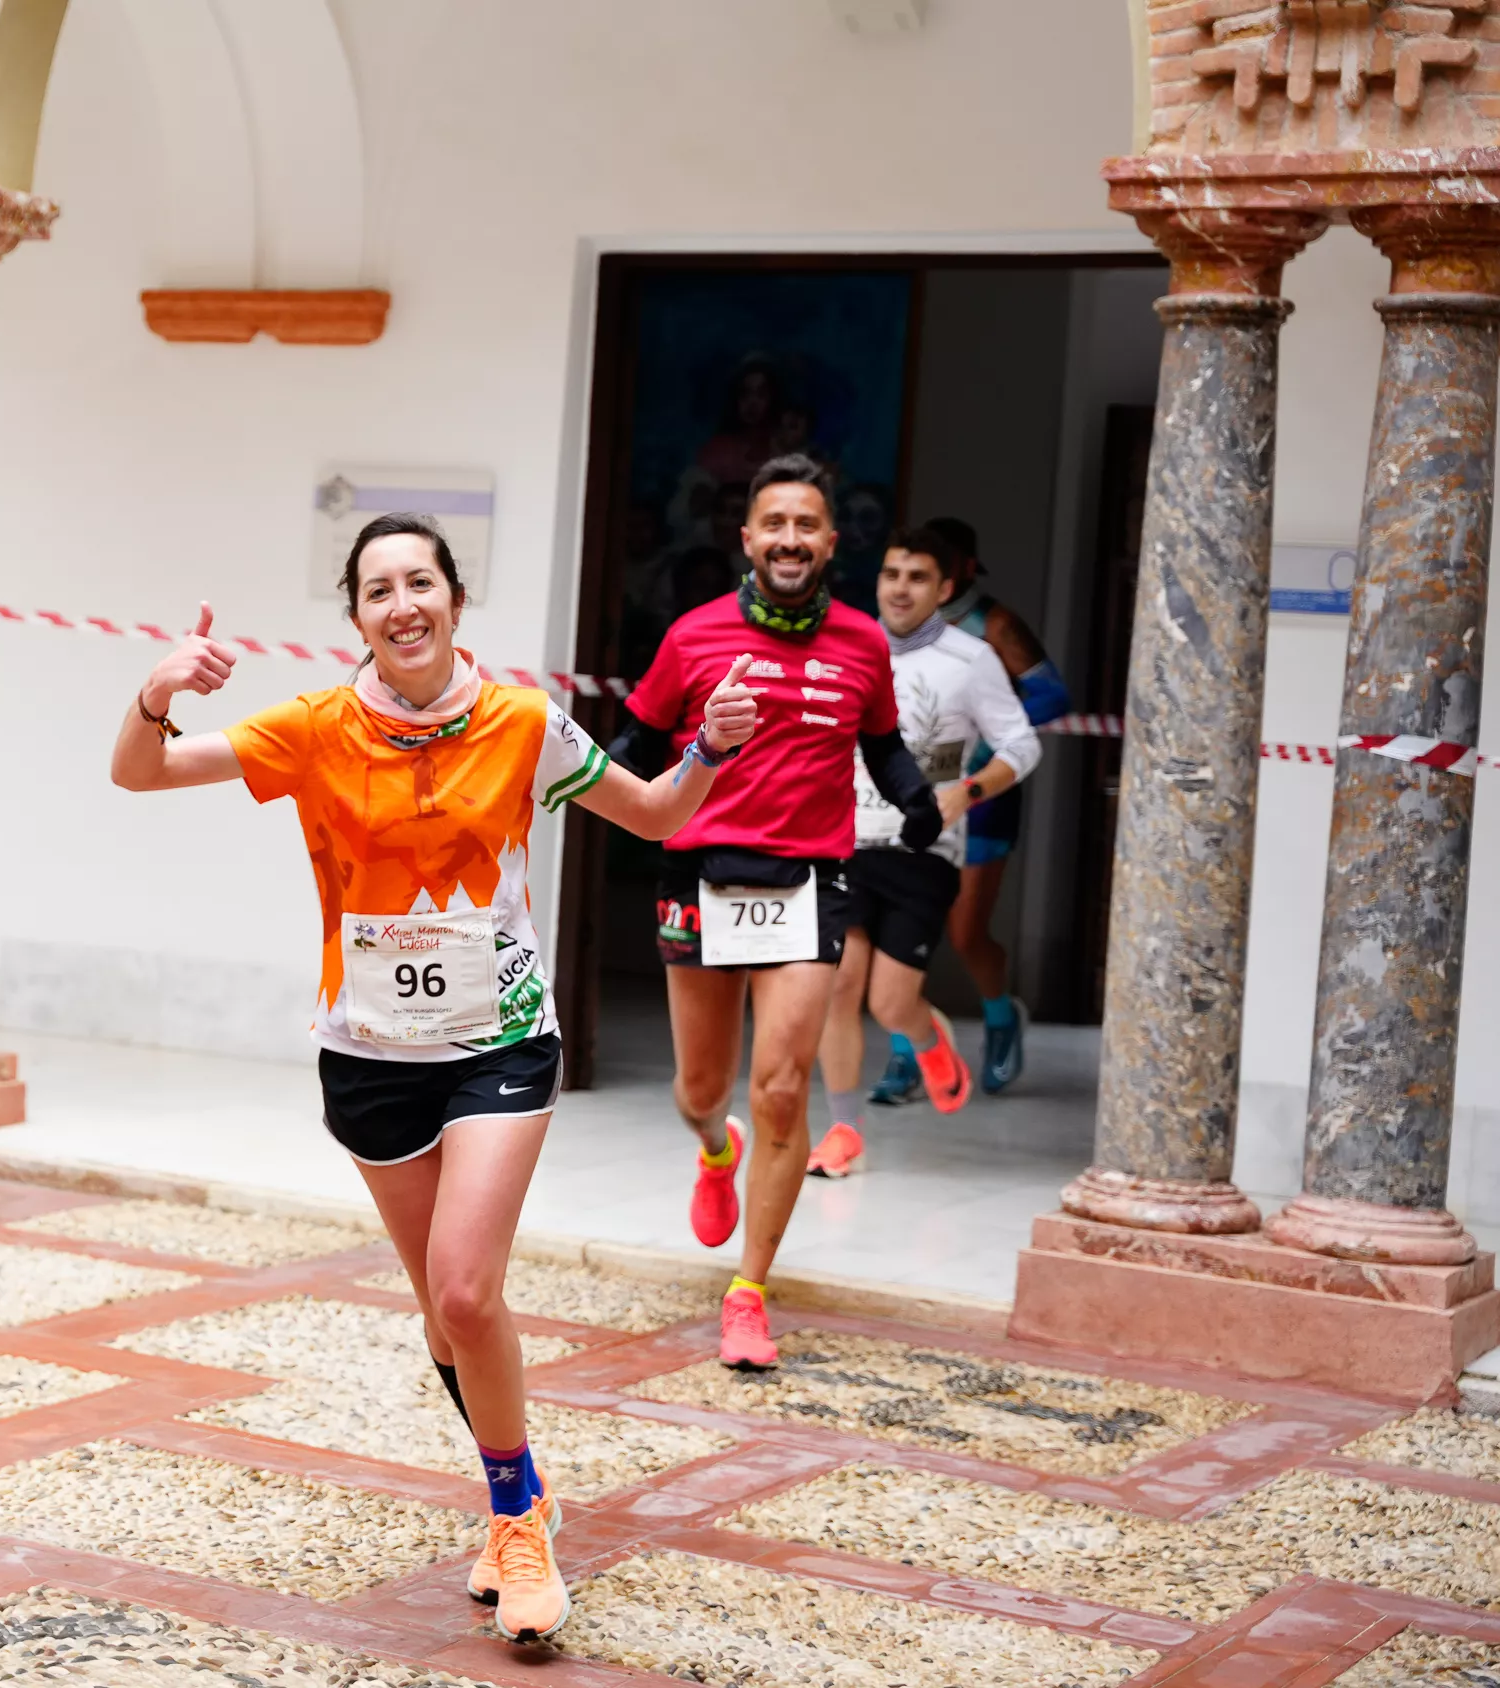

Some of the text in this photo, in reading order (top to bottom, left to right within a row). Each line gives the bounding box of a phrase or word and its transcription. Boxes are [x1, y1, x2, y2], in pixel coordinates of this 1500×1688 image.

[731, 900, 787, 926] 702
[399, 938, 443, 950] LUCENA
[395, 963, 446, 998] 96
